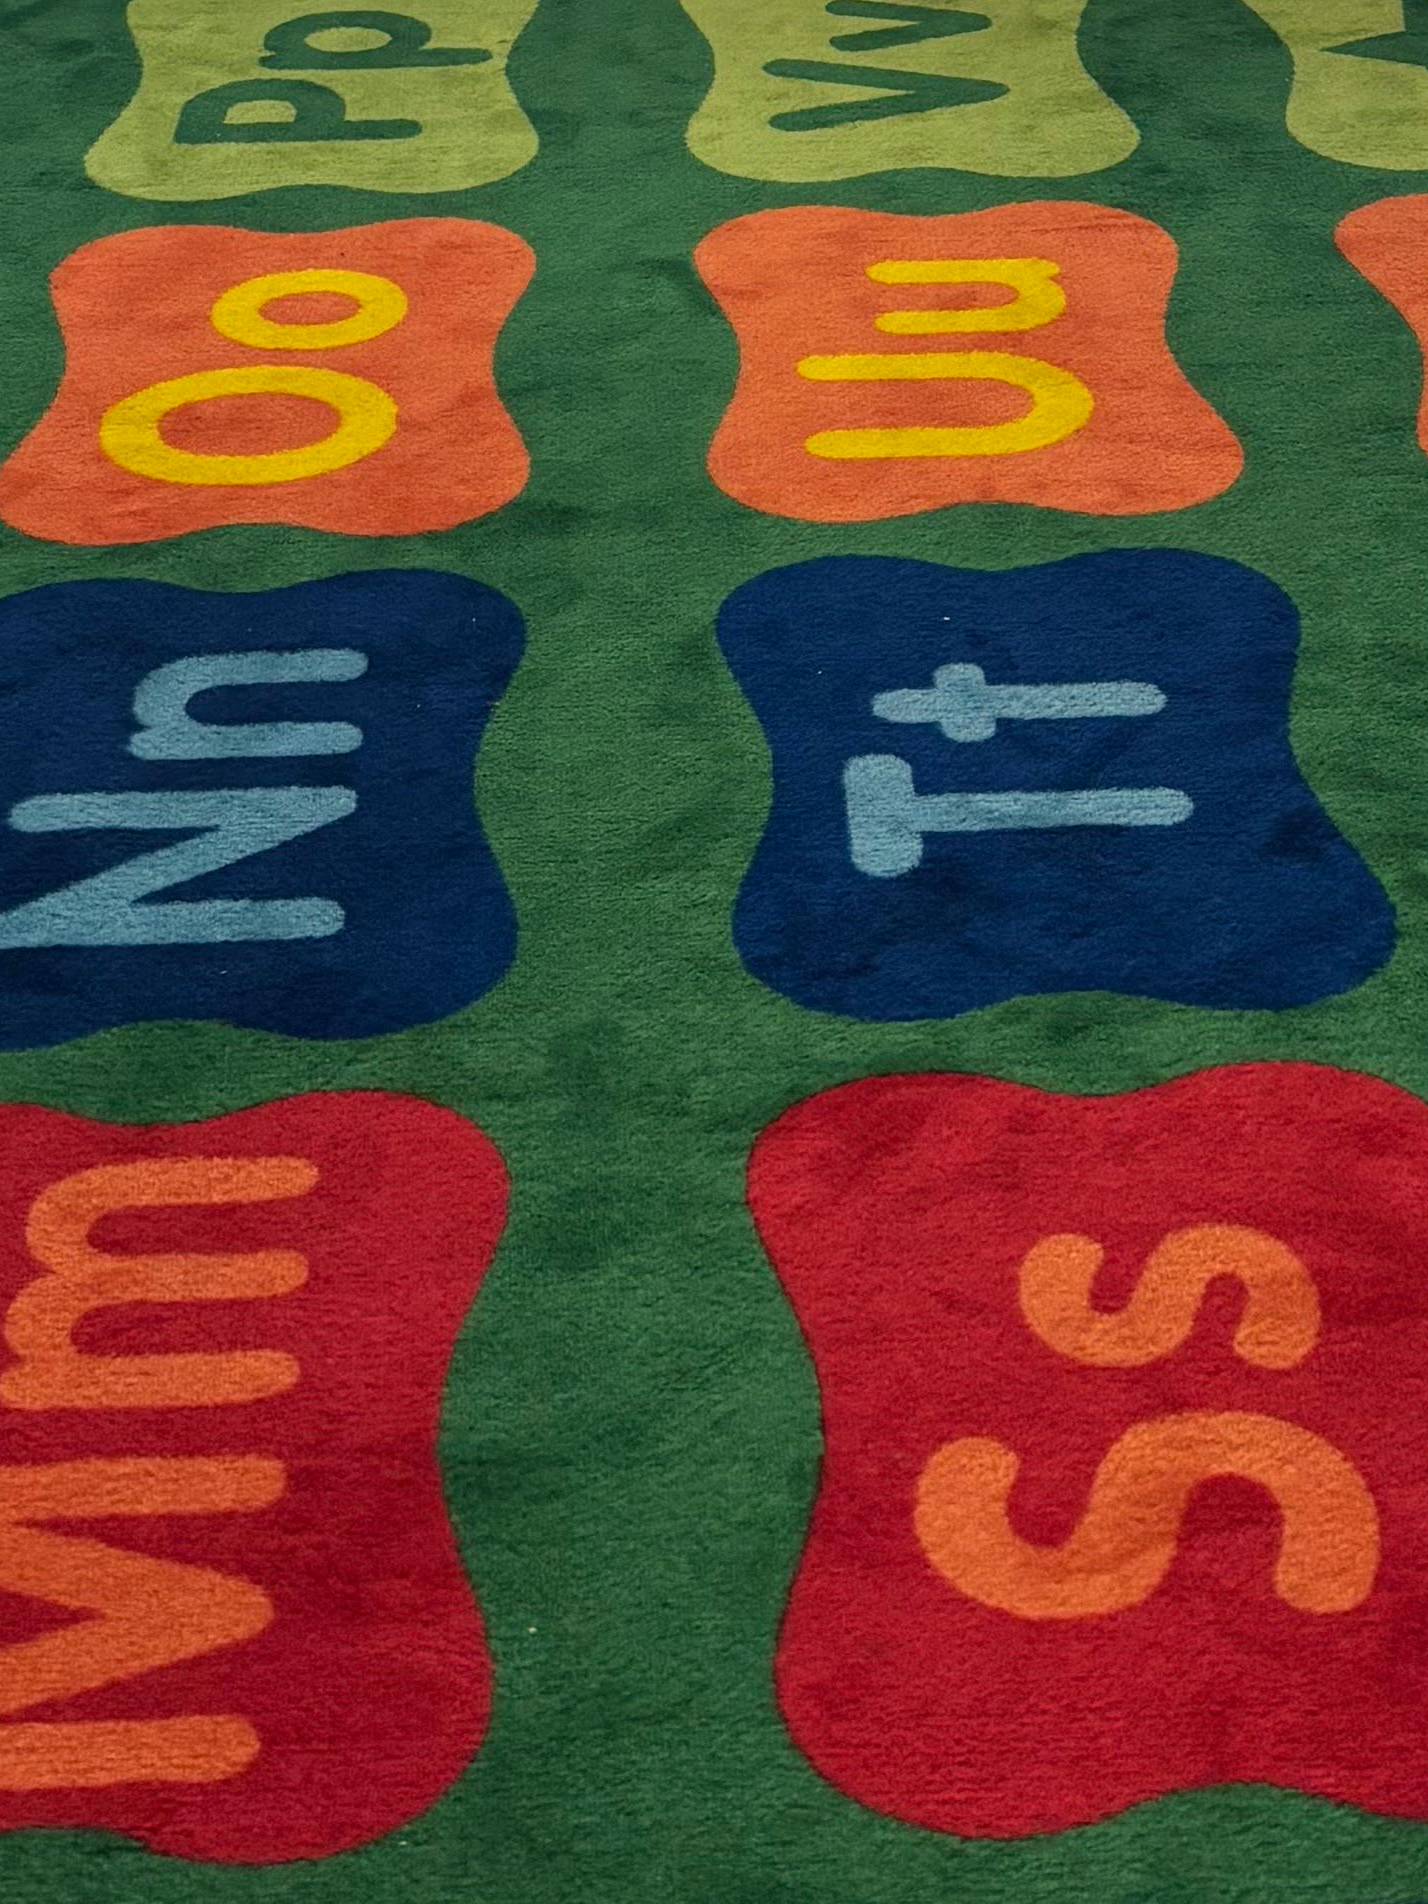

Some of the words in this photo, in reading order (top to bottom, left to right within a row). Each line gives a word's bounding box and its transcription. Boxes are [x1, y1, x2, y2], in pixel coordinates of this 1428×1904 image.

[174, 8, 493, 145] Pp
[99, 267, 406, 488] Oo
[796, 257, 1093, 460] Uu
[841, 662, 1193, 878] Tt
[912, 1219, 1381, 1620] Ss
